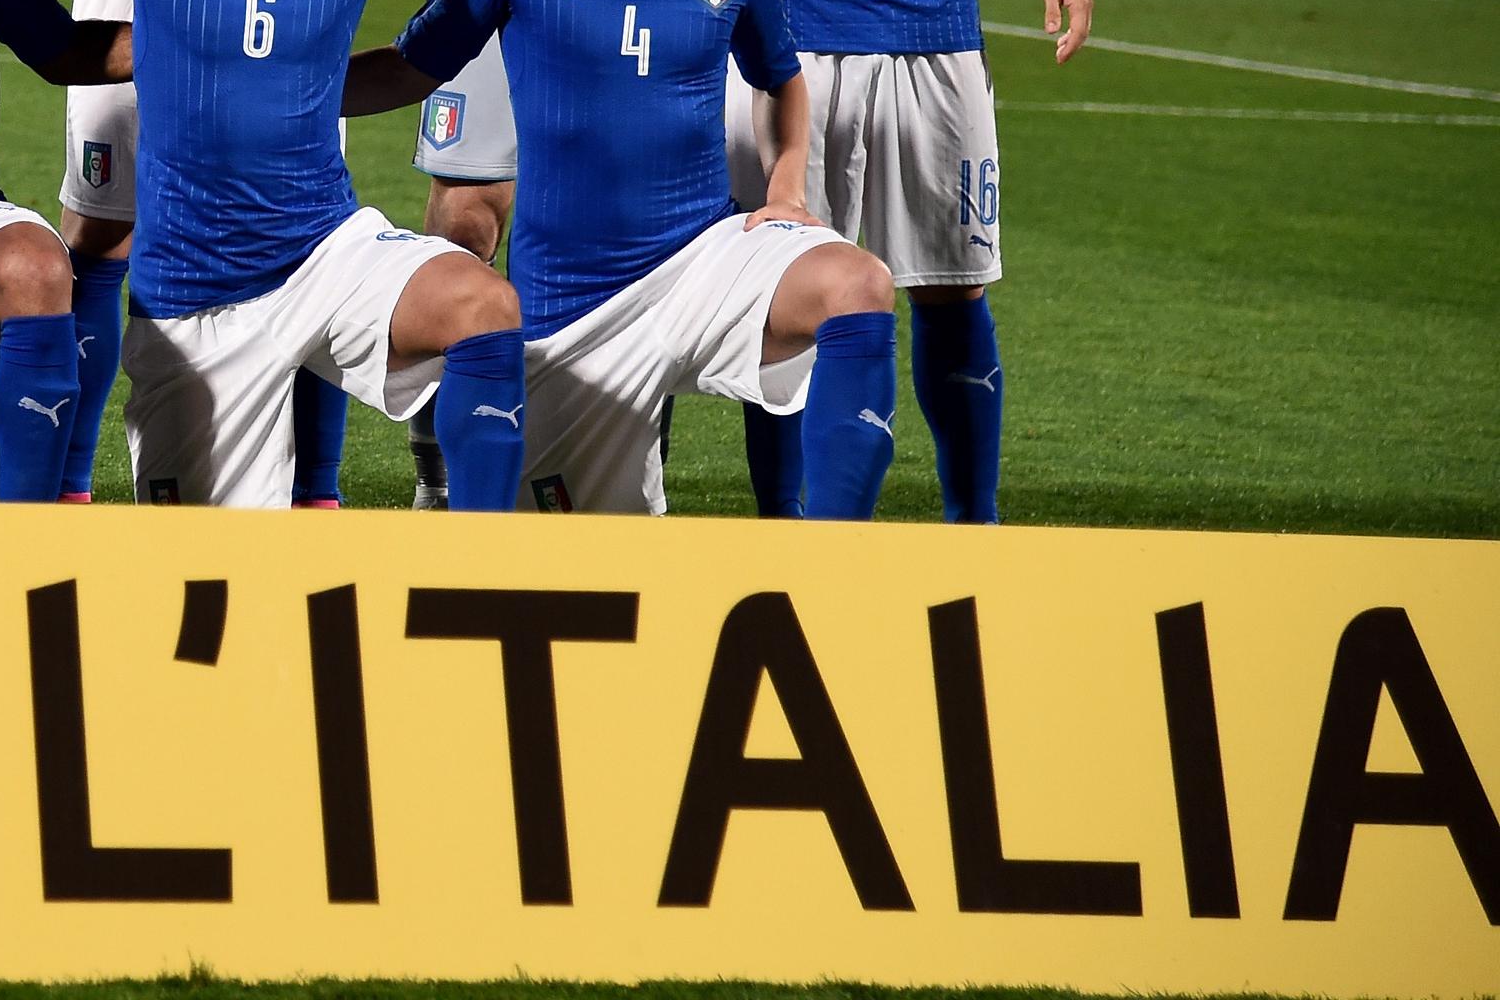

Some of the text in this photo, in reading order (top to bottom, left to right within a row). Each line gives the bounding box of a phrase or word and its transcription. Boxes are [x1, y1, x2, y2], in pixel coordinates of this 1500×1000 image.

[621, 5, 650, 76] 4
[432, 98, 455, 107] ITALIA
[957, 160, 997, 227] 16
[27, 579, 1500, 926] L'ITALIA
